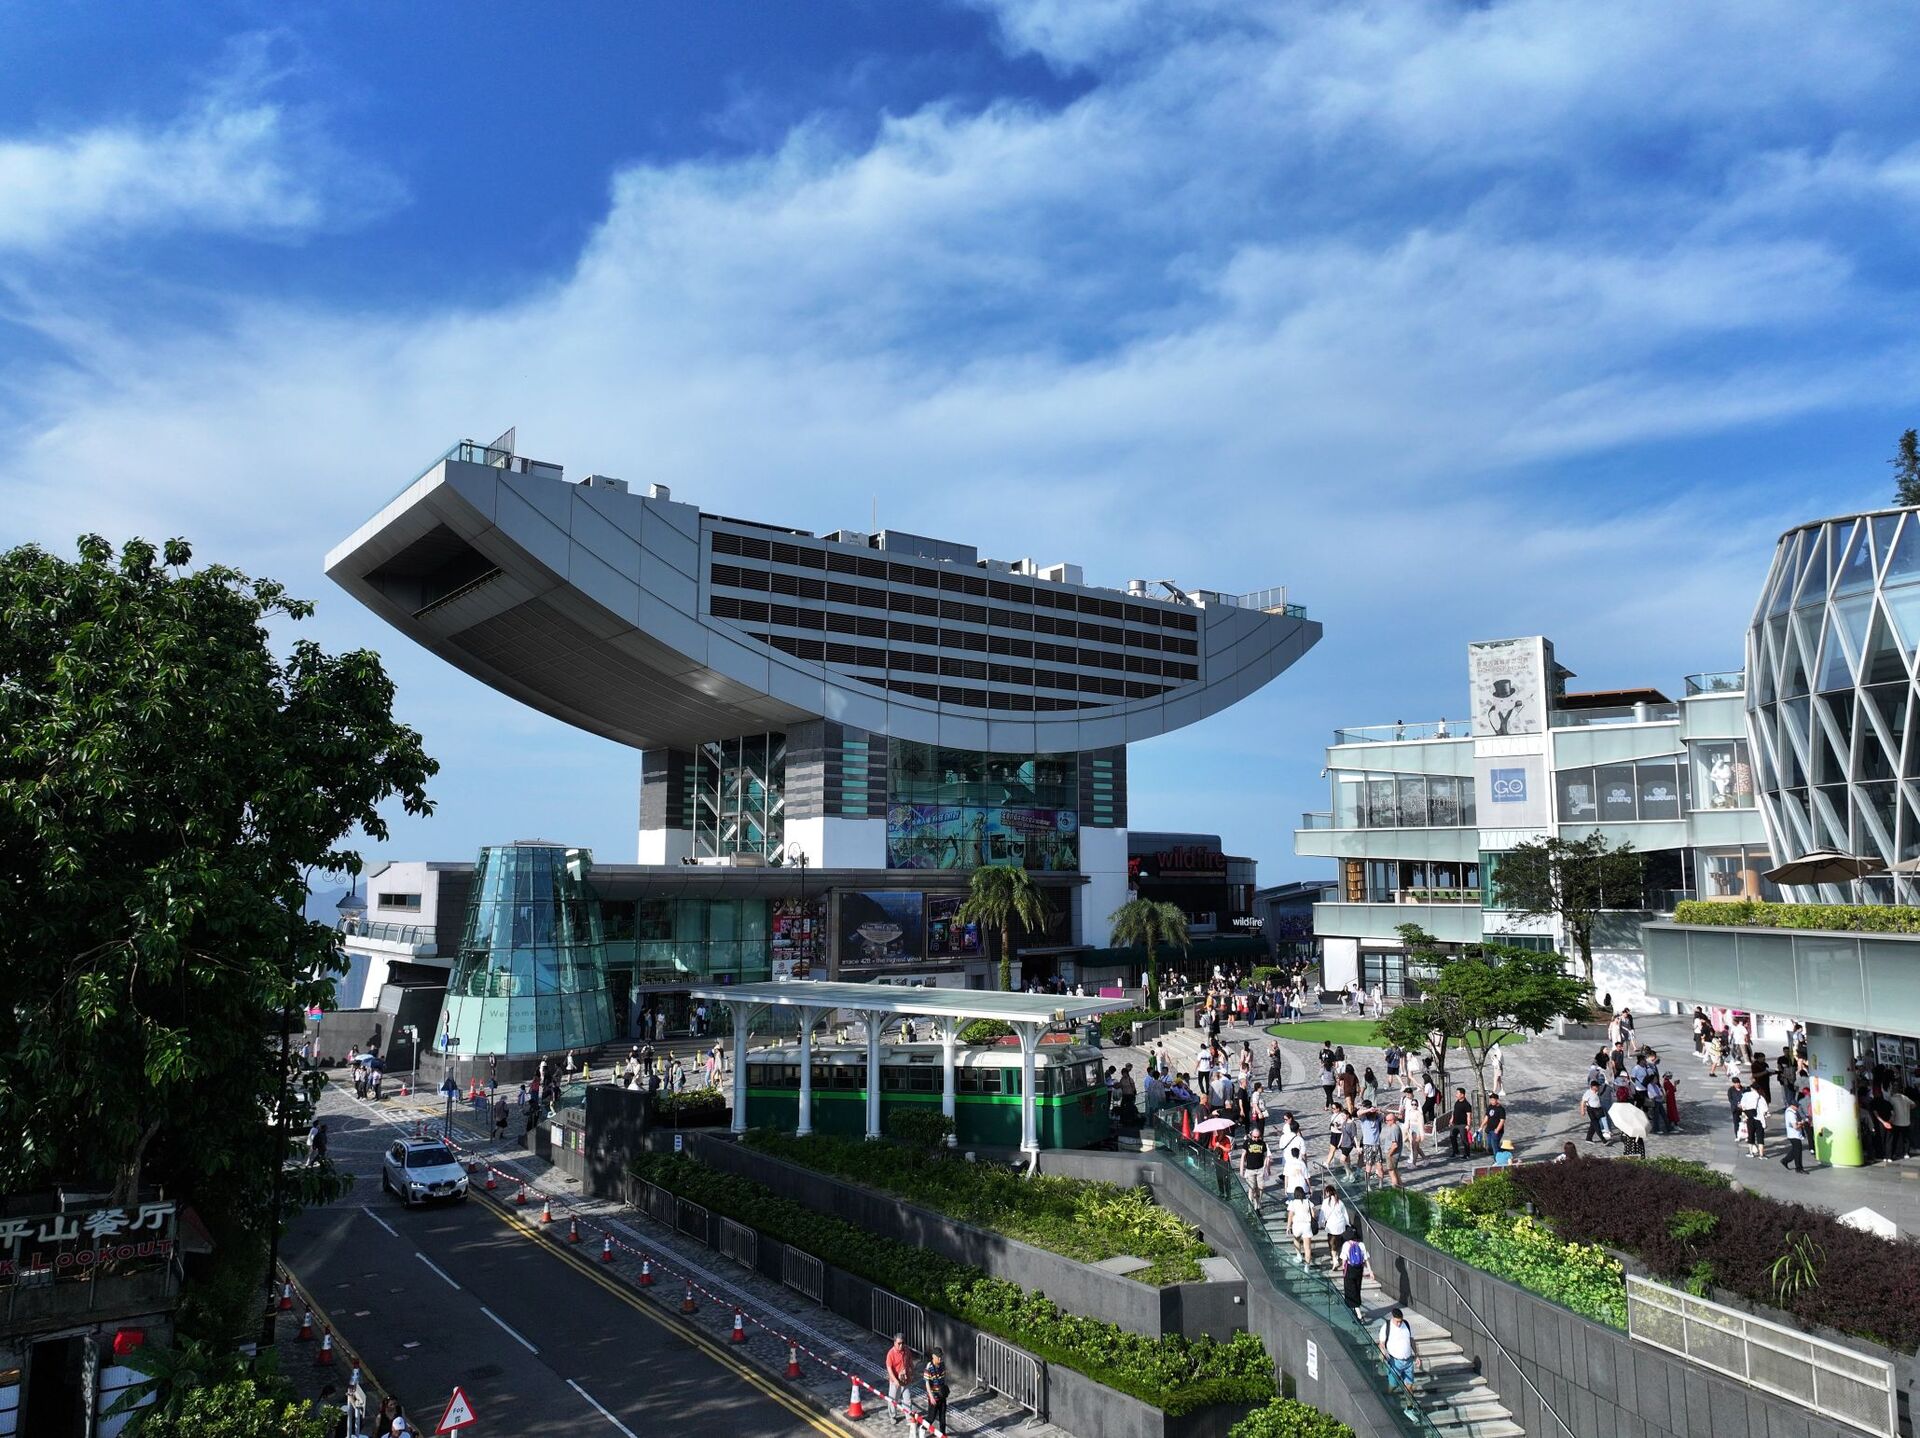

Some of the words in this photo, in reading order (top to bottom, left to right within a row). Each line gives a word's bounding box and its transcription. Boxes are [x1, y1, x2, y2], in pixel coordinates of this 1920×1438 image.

[1494, 779, 1523, 793] GO
[1607, 796, 1632, 804] Dining
[1157, 846, 1225, 869] wildfire
[1232, 916, 1263, 927] wildfire
[489, 1008, 535, 1017] Welcome
[31, 1240, 174, 1271] LOOKOUT
